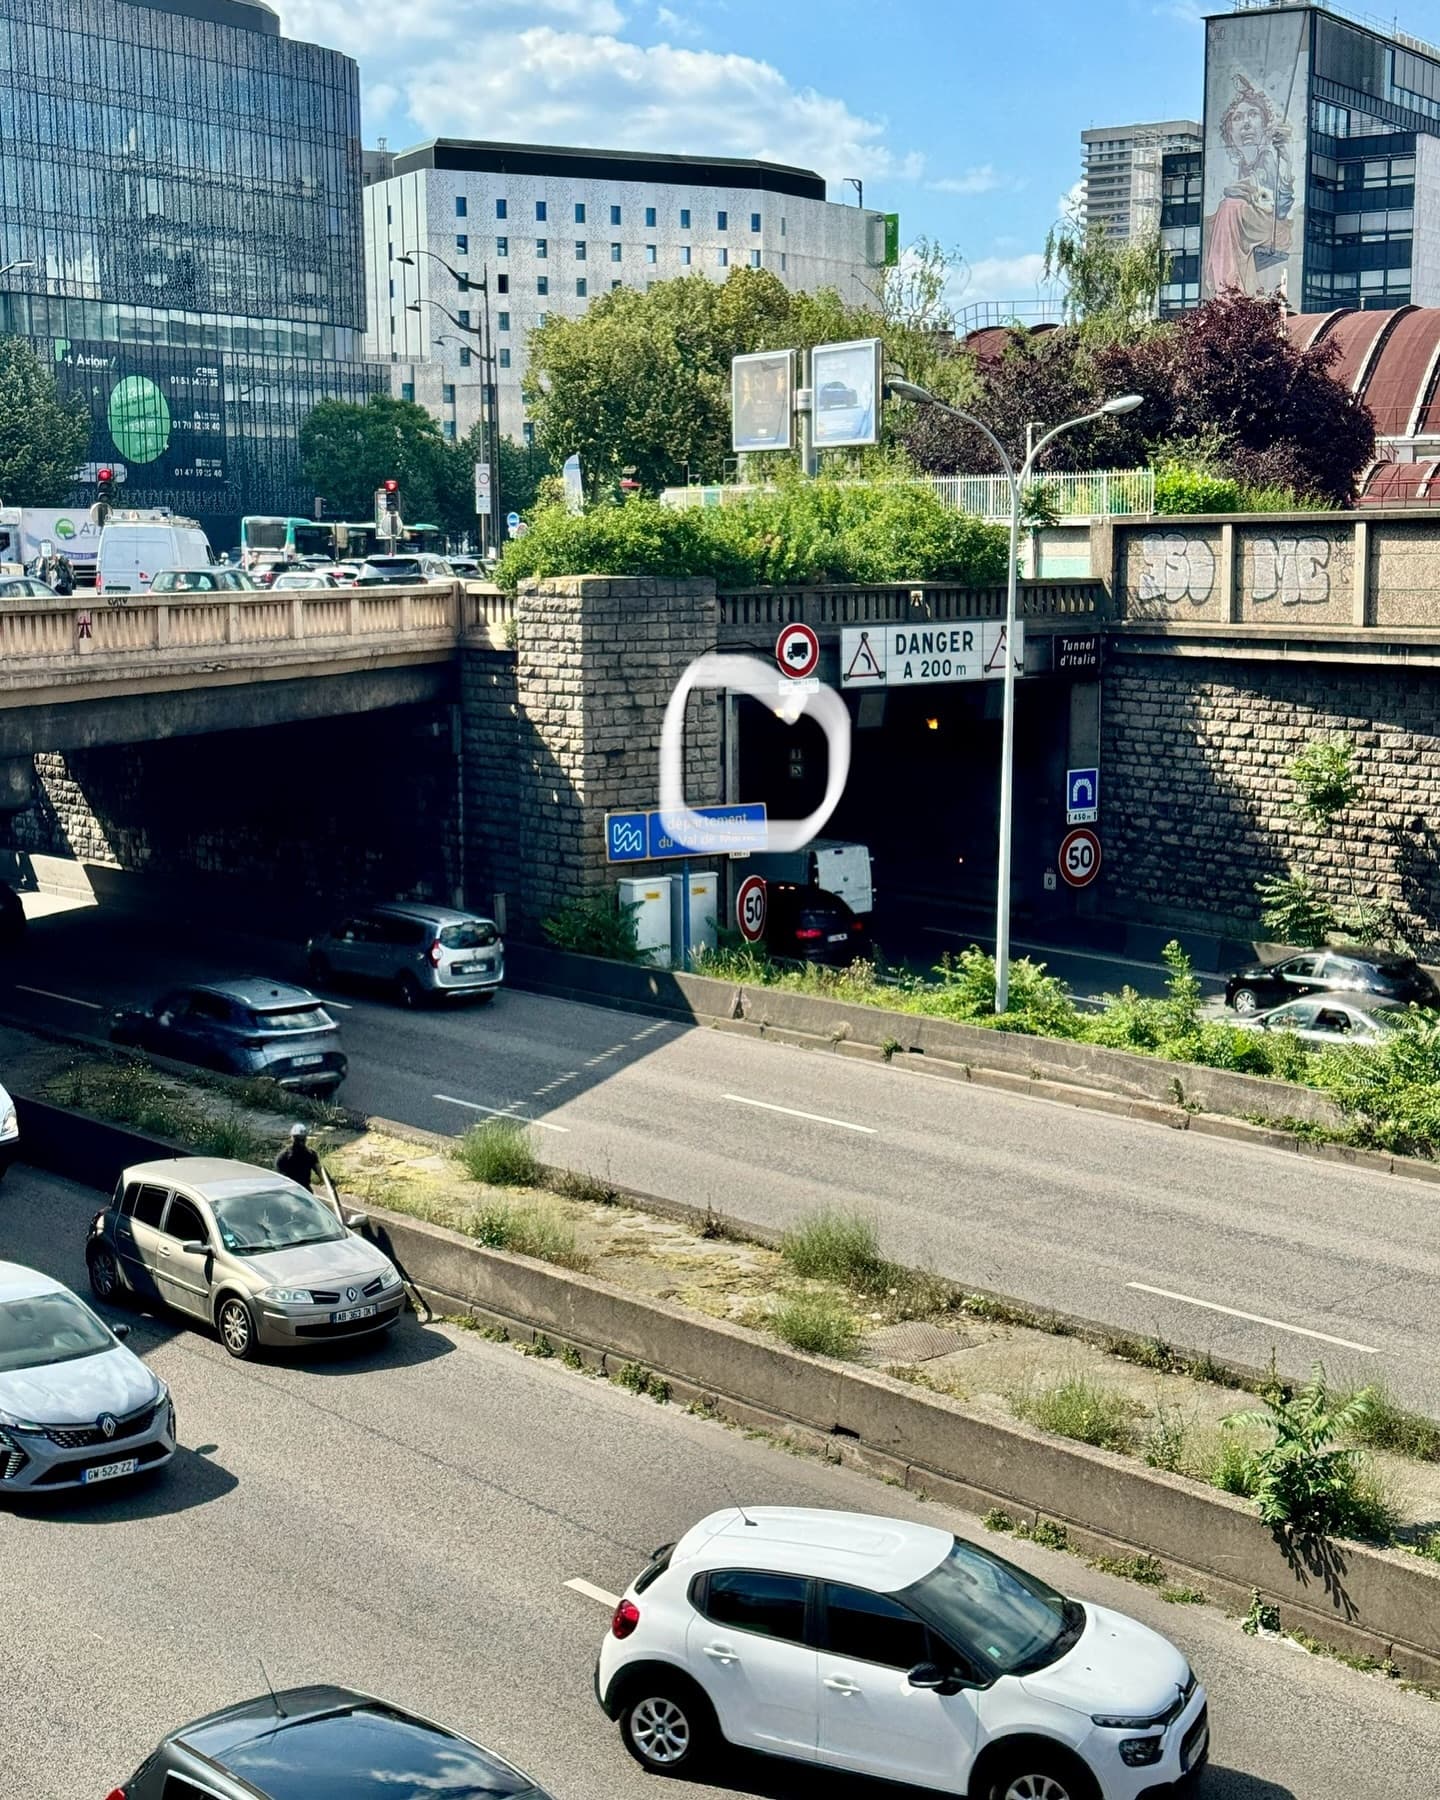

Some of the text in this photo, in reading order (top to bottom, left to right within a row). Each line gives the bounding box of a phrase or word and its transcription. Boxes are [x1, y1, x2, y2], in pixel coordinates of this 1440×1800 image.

[895, 631, 974, 655] DANGER
[1062, 637, 1095, 651] Tunnel
[904, 659, 967, 679] A 200 m
[1060, 653, 1096, 666] d'Italie
[658, 836, 674, 849] du
[678, 833, 697, 845] Val
[700, 833, 715, 845] de
[1068, 845, 1093, 870] 50
[745, 895, 762, 924] 50
